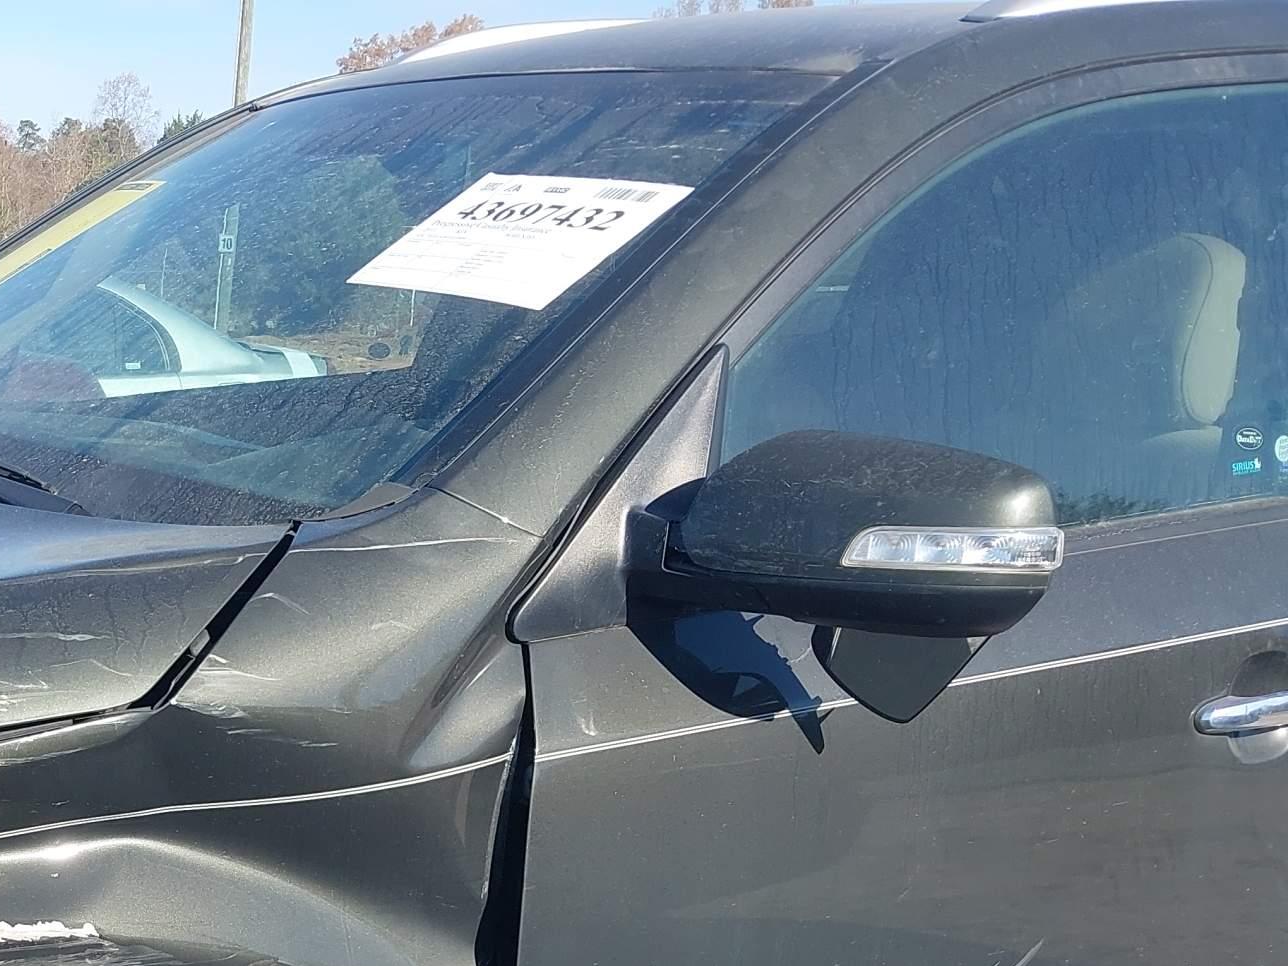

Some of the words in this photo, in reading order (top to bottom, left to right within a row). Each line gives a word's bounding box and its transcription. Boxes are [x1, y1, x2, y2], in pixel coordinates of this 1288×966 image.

[456, 199, 627, 232] 43697432
[221, 237, 232, 250] 10
[1232, 461, 1255, 472] SIRIUS
